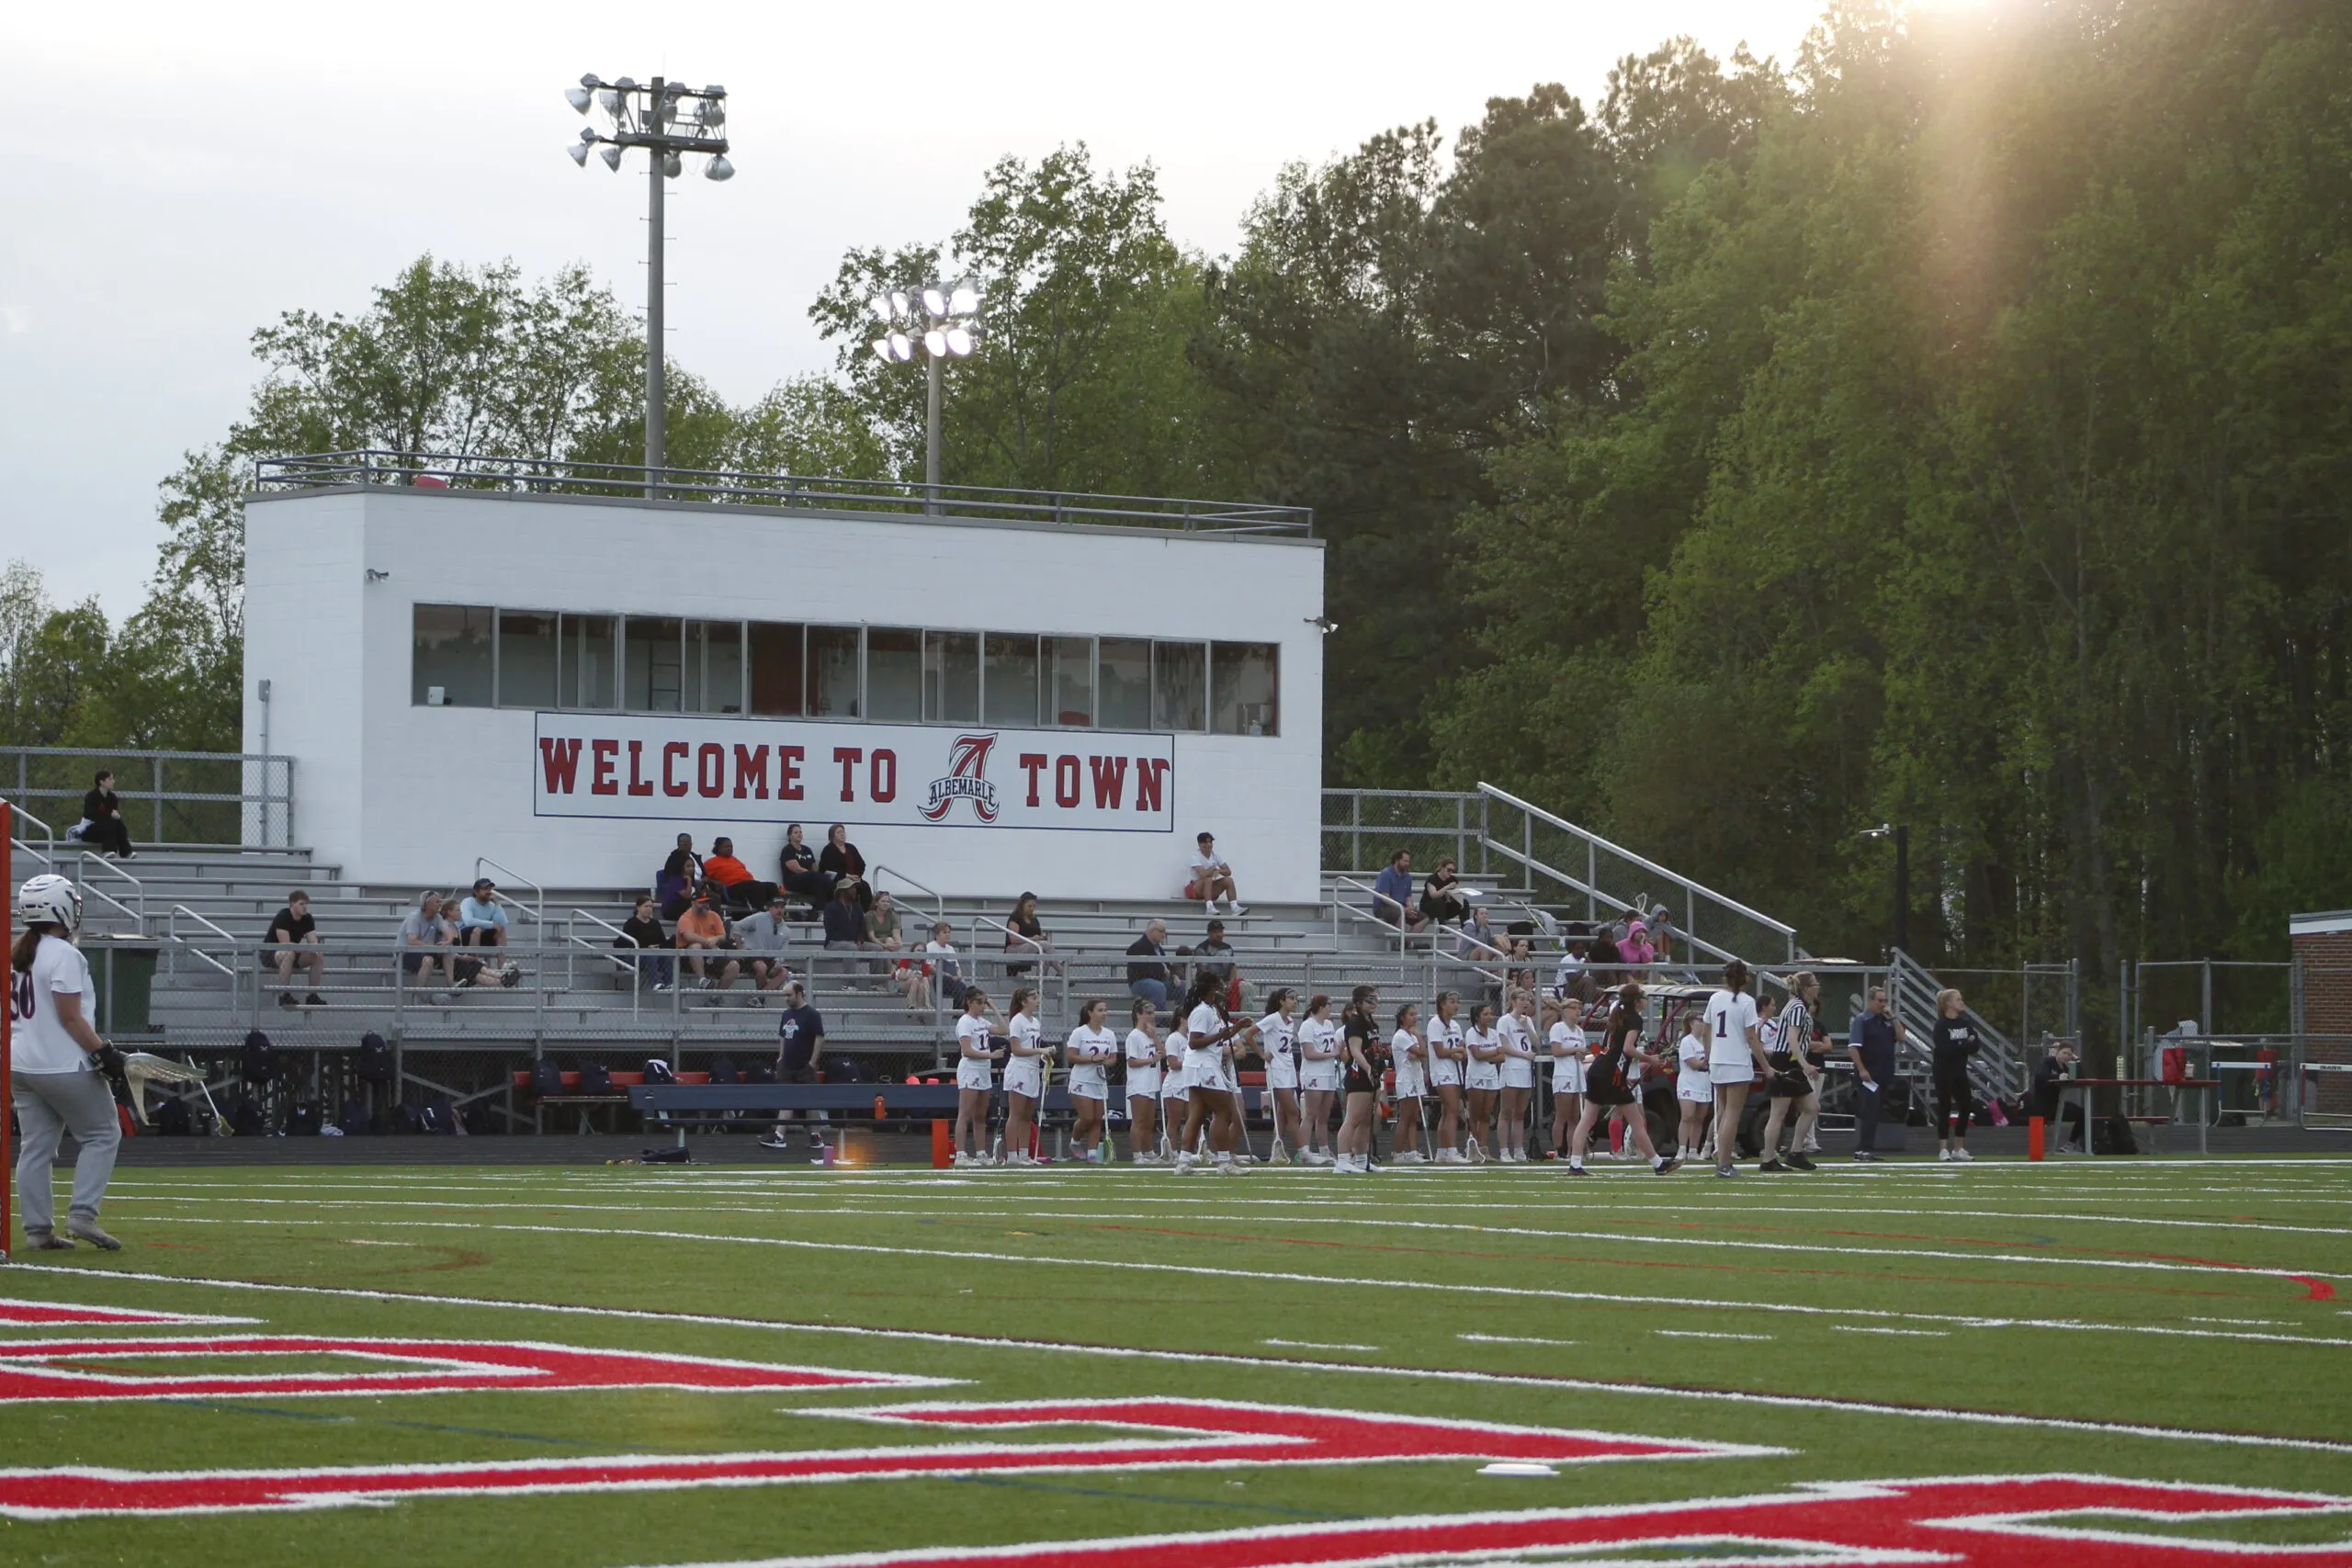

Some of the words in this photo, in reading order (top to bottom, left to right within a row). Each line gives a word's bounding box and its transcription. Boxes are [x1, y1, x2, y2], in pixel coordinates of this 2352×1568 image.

[538, 737, 805, 801] WELCOME
[833, 747, 897, 803] TO
[1020, 753, 1170, 812] TOWN
[929, 778, 997, 807] ALBEMARLE
[1715, 1010, 1727, 1038] 1
[1521, 1036, 1529, 1052] 6
